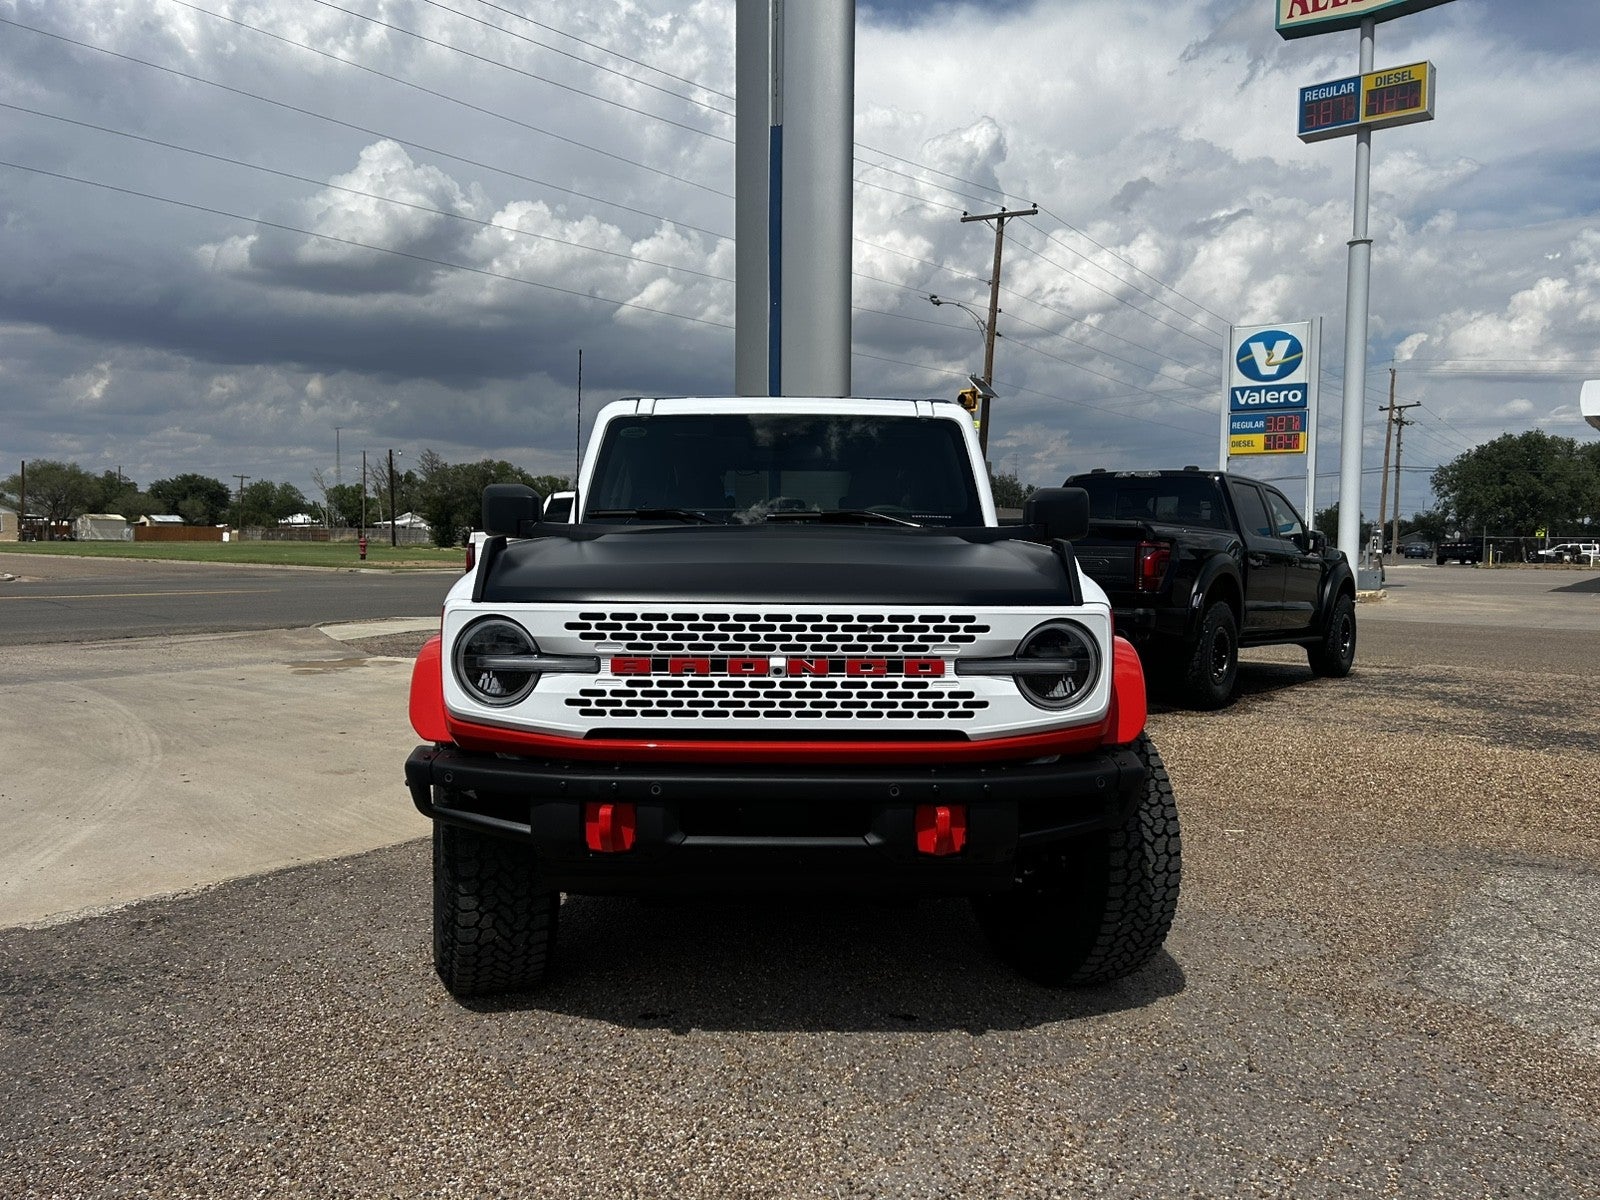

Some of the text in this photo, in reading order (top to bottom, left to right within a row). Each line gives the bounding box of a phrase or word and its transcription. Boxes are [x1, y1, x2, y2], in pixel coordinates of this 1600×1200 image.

[1375, 70, 1415, 88] DIESEL
[1305, 82, 1355, 102] REGULAR
[1235, 389, 1302, 405] Valero
[1232, 421, 1265, 429] REGULAR
[1231, 440, 1255, 448] DIESEL
[610, 657, 945, 676] BRONCO
